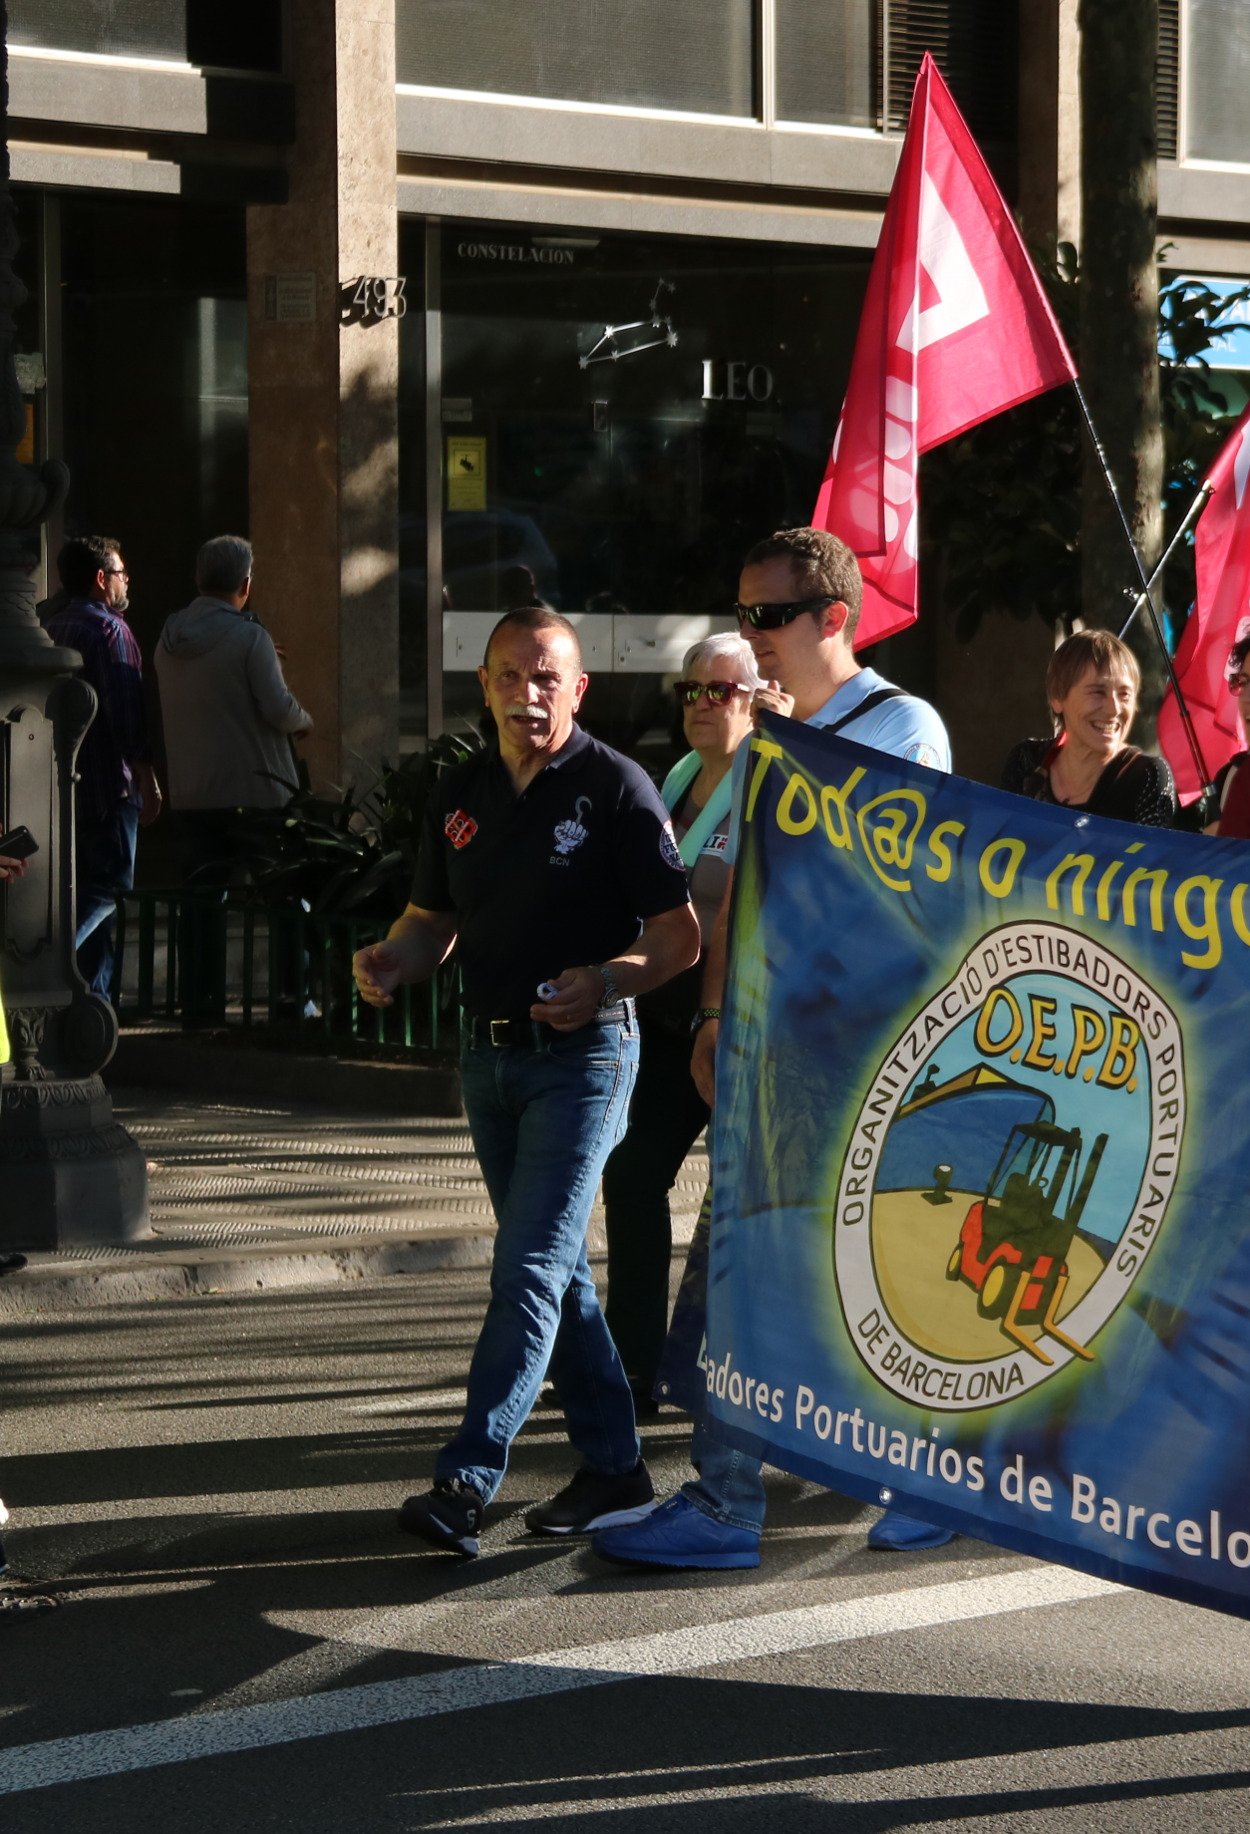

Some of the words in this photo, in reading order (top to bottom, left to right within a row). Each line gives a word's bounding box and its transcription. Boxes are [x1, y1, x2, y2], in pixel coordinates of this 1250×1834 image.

[353, 275, 407, 318] 493
[701, 359, 775, 400] LEO
[549, 855, 570, 867] BCN
[745, 737, 966, 892] Tod@s
[978, 838, 1027, 899] o
[842, 961, 984, 1227] ORGANITZACIÓ
[982, 934, 1168, 1041] D'ESTIBADORS
[1116, 1044, 1180, 1278] PORTUARIS
[857, 1308, 890, 1356] DE
[880, 1348, 1025, 1402] BARCELONA
[795, 1384, 985, 1492] Portuarios
[999, 1454, 1053, 1513] de
